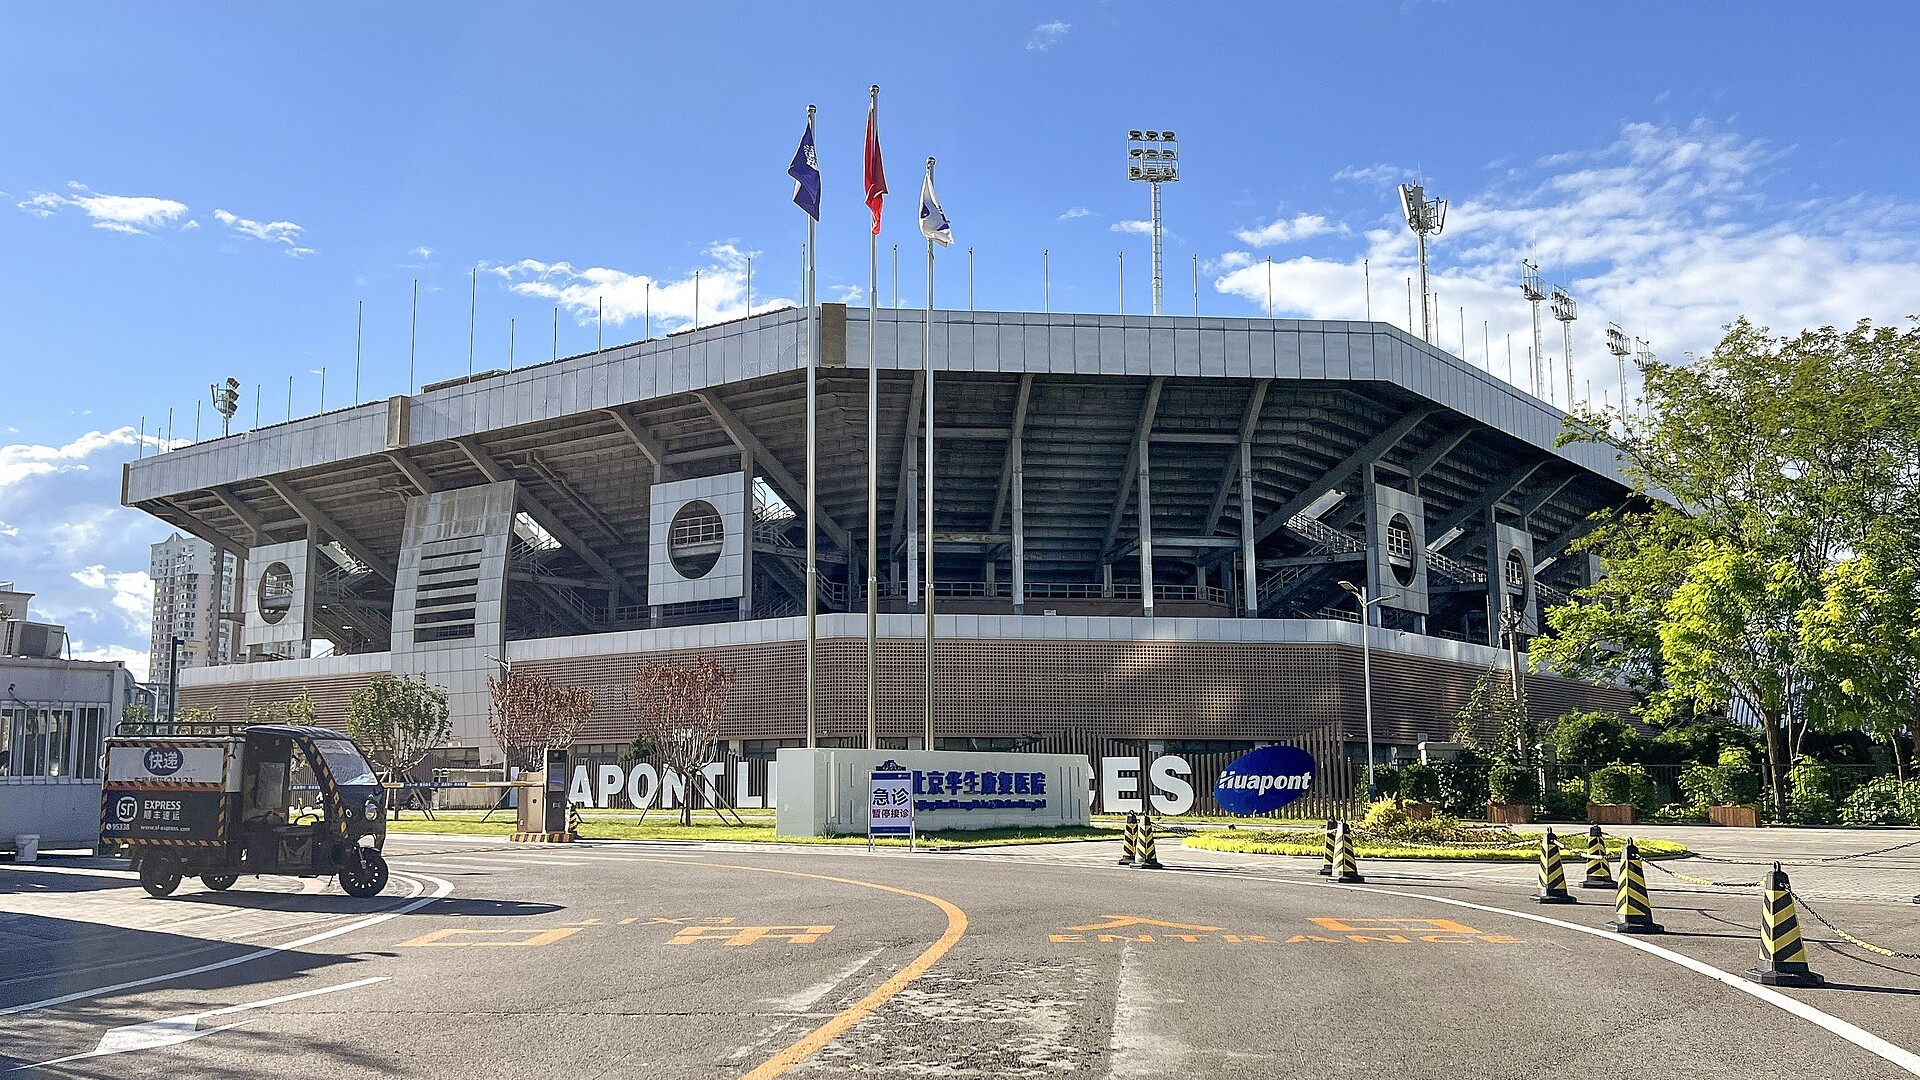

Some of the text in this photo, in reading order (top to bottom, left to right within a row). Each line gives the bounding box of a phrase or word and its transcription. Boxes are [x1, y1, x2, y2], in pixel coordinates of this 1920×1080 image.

[149, 752, 178, 769] 快递
[510, 761, 724, 808] APONT
[1218, 770, 1311, 796] Huapont
[873, 788, 909, 805] 急诊
[144, 800, 181, 810] EXPRESS
[872, 809, 909, 818] 暂停接诊
[112, 823, 130, 831] 95338
[1048, 934, 1528, 944] ENTRANCE
